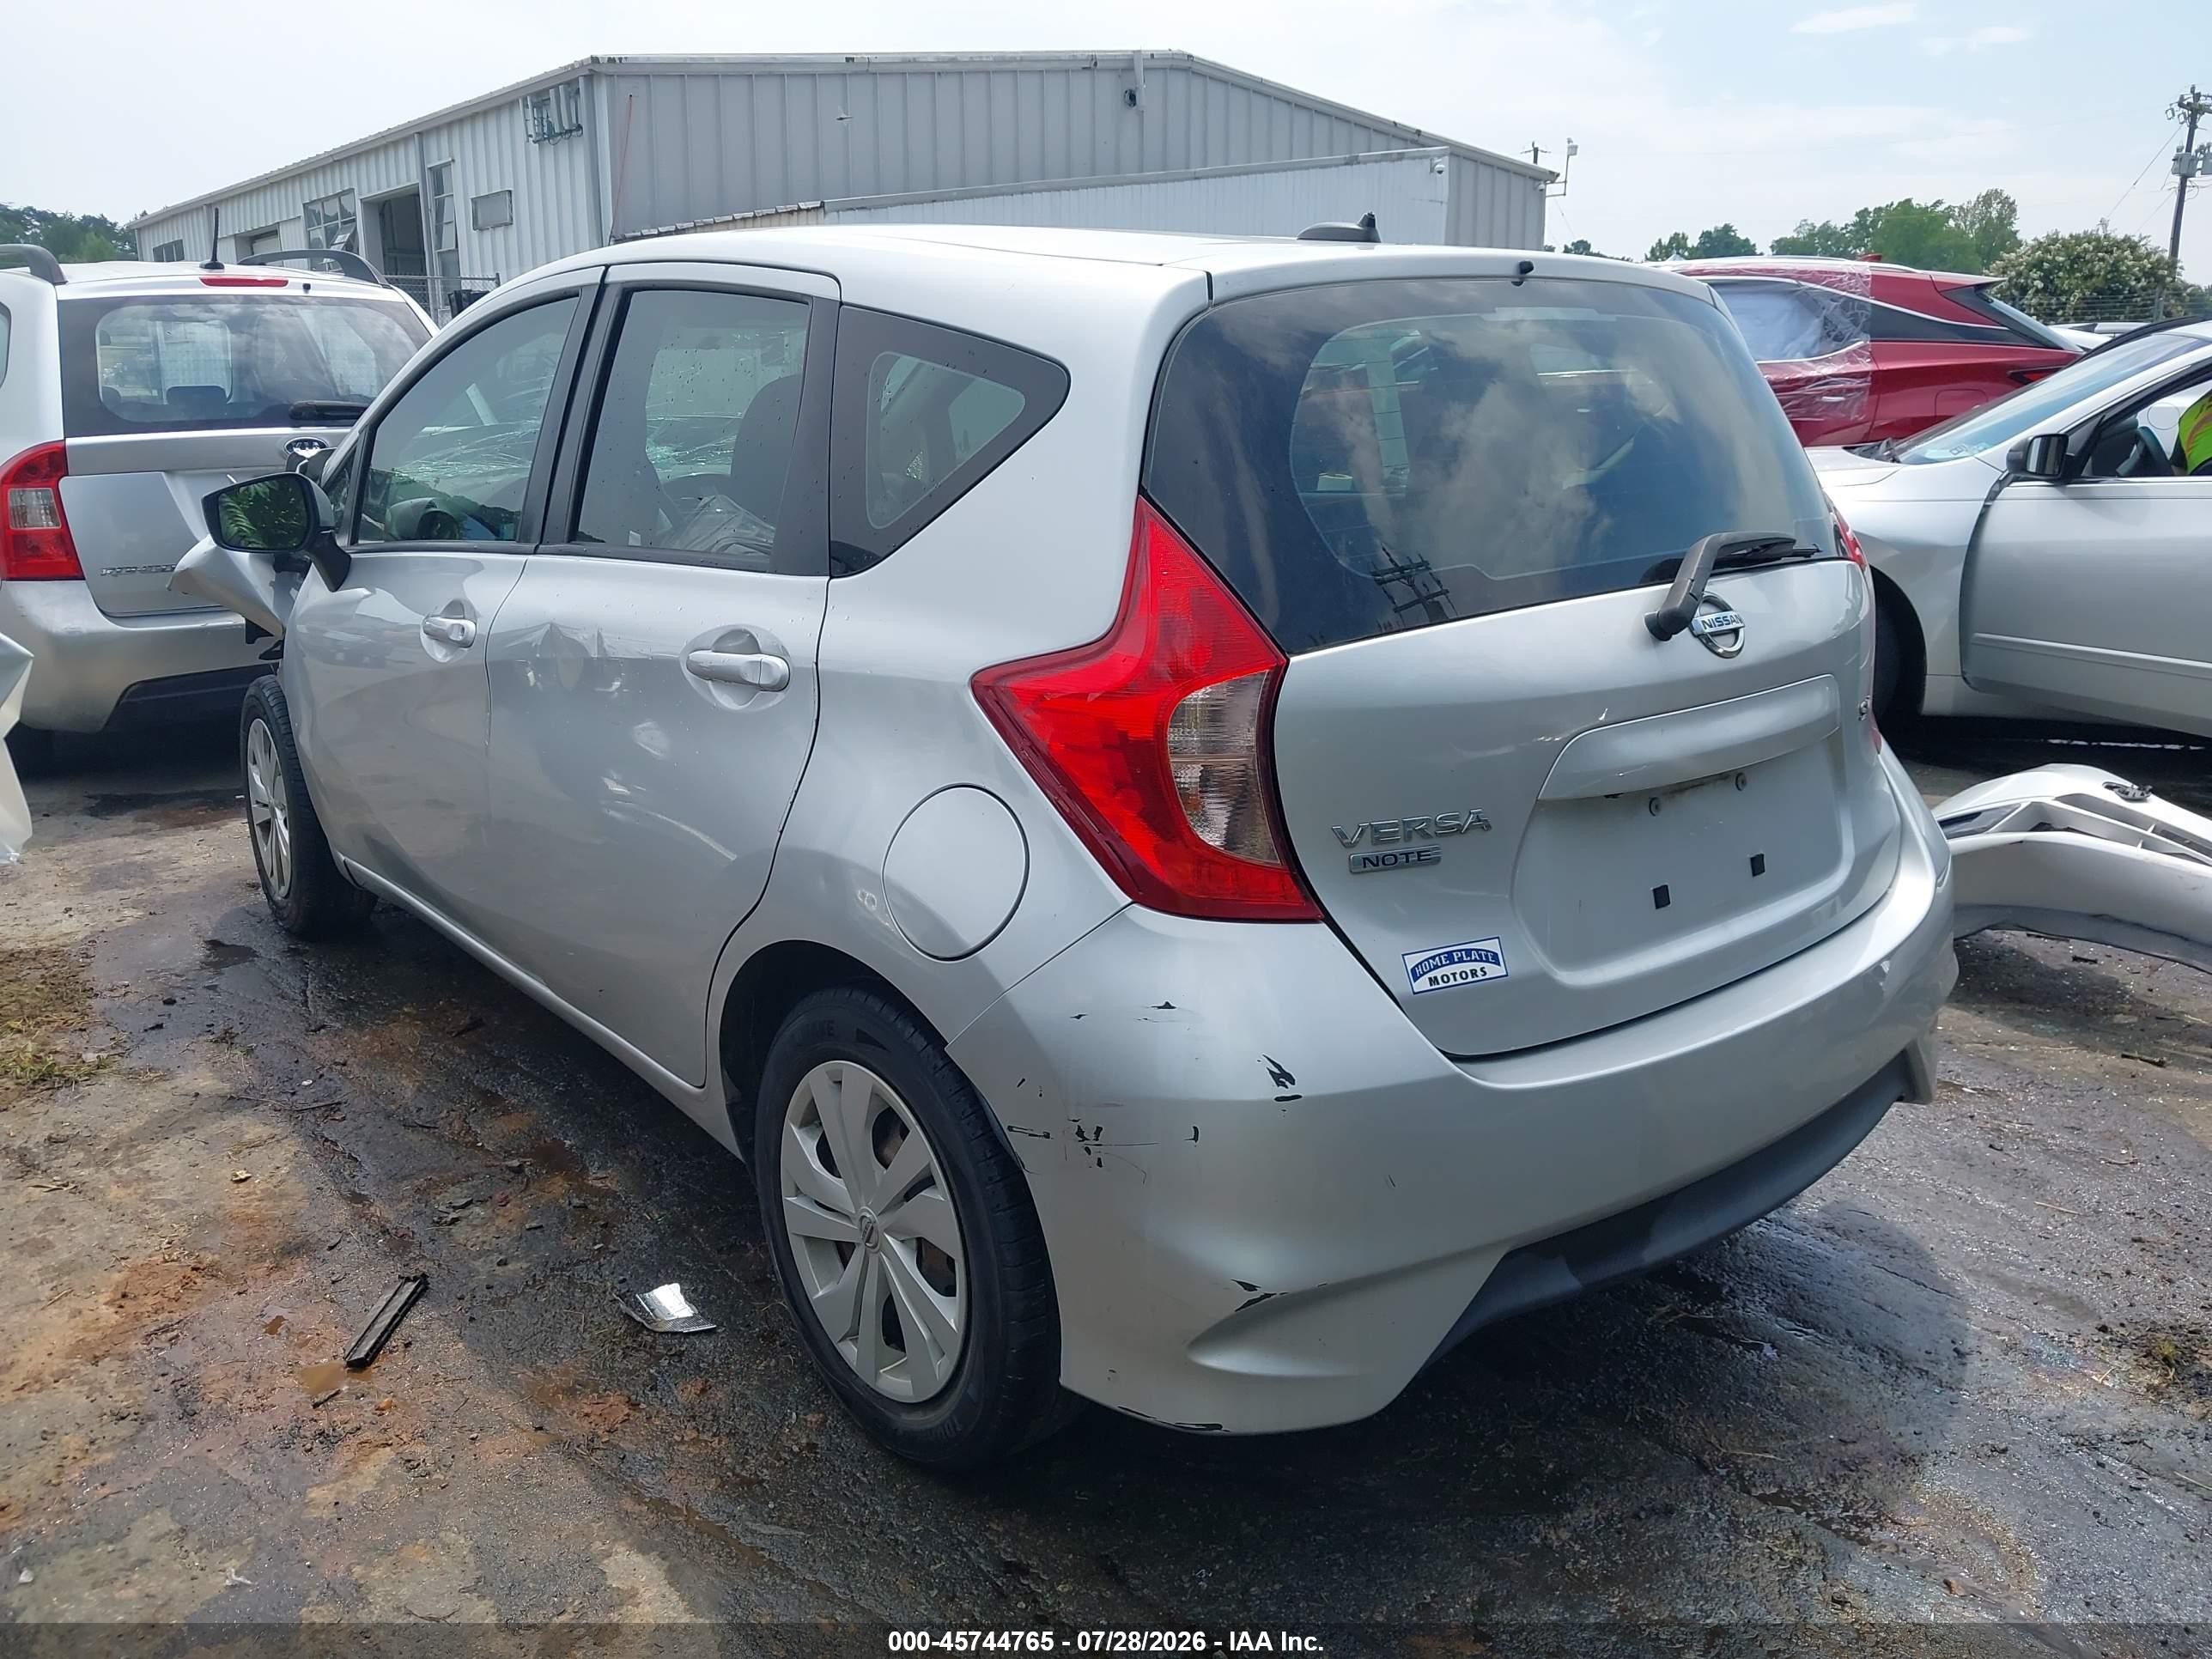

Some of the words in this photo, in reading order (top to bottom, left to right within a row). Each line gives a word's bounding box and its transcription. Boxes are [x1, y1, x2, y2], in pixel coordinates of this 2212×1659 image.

[1701, 615, 1743, 629] NISSAN
[1331, 808, 1492, 848] VERSA
[1362, 849, 1432, 868] NOTE
[1414, 953, 1450, 977] HOME
[1451, 949, 1496, 963] PLATE
[1427, 966, 1487, 988] MOTORS
